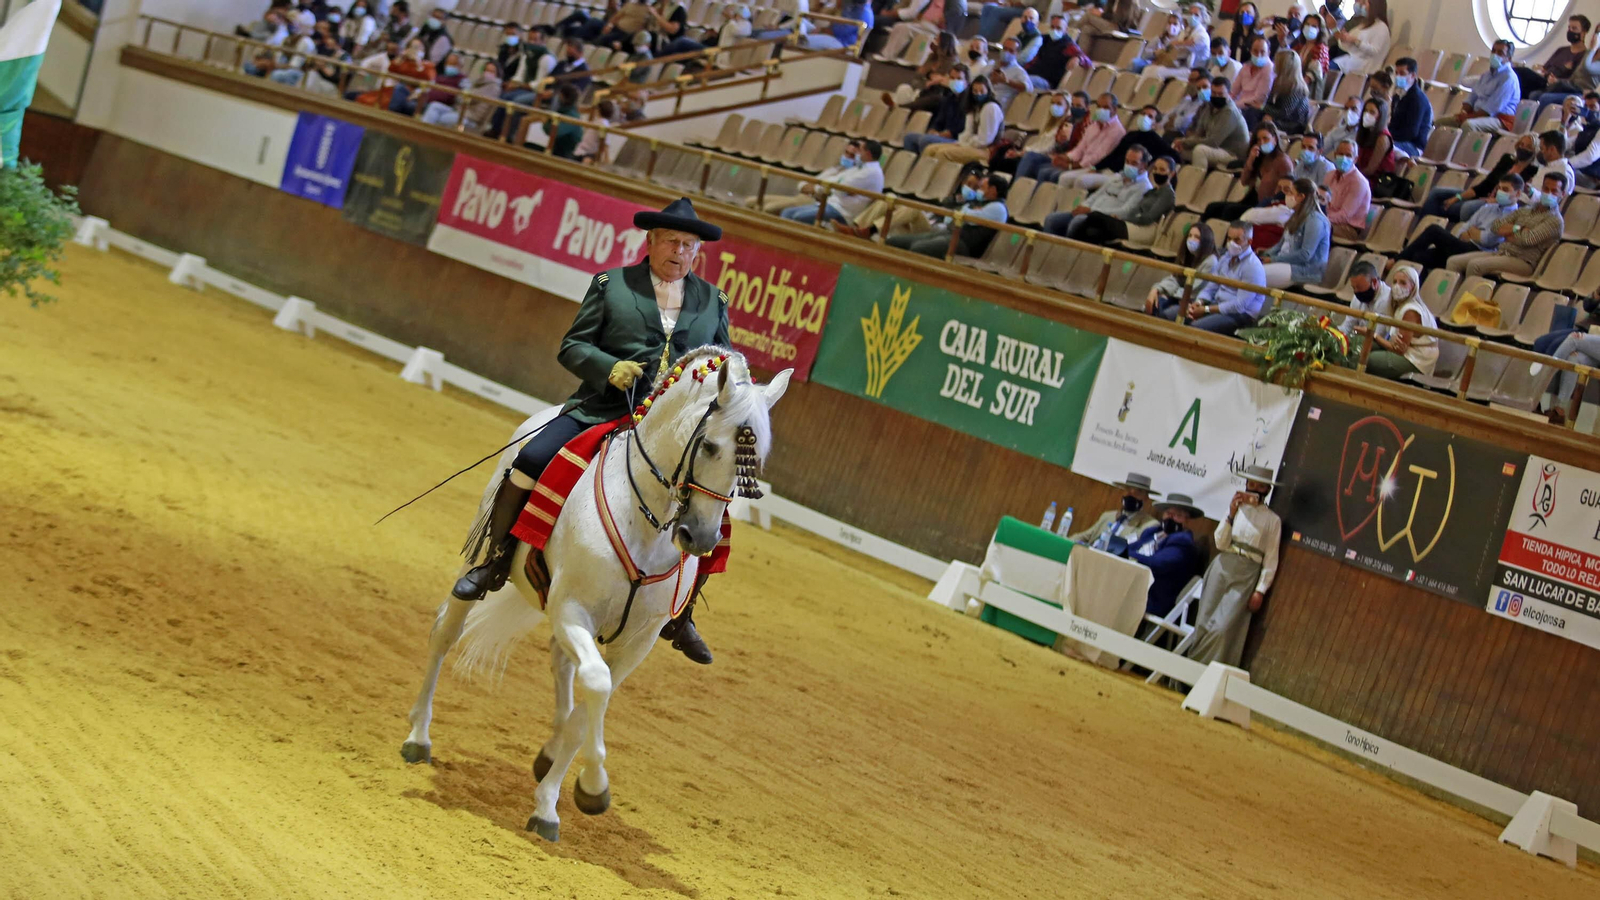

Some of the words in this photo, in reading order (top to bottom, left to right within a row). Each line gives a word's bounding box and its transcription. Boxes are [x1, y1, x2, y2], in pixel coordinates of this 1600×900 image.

[452, 168, 508, 229] Pavo
[553, 198, 615, 264] Pavo
[939, 319, 988, 365] CAJA
[990, 334, 1065, 389] RURAL
[939, 363, 984, 409] DEL
[989, 380, 1041, 426] SUR
[1146, 449, 1166, 465] Junta
[1166, 455, 1176, 468] de
[1175, 458, 1207, 478] Andalucía
[1522, 537, 1553, 557] TIENDA
[1541, 559, 1566, 577] TODO
[1566, 567, 1577, 580] LO
[1503, 570, 1528, 590] SAN
[1528, 578, 1566, 602] LUCAR
[1564, 589, 1586, 608] DE
